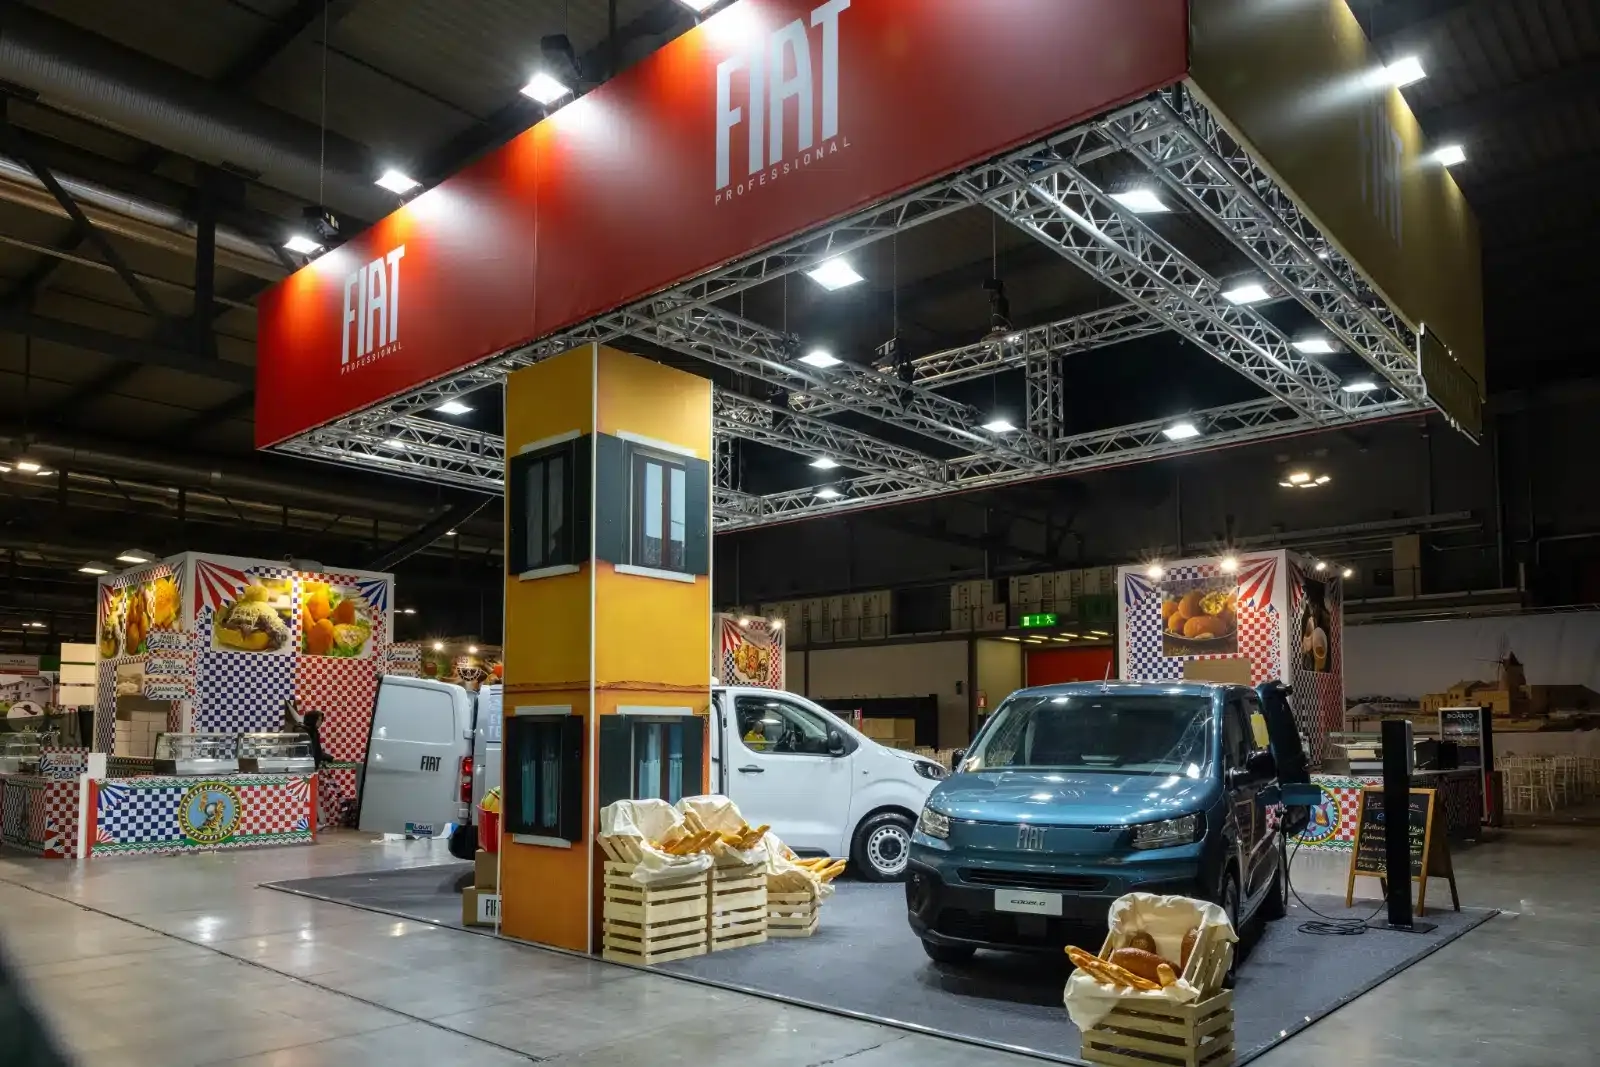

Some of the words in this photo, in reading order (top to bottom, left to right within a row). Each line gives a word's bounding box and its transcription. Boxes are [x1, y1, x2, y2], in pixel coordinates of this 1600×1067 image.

[716, 0, 851, 190] FIAT
[714, 136, 851, 206] PROFESSIONAL
[341, 244, 405, 365] FIAT
[341, 341, 403, 375] PROFESSIONAL
[420, 755, 442, 772] FIAT
[1016, 824, 1048, 849] FIAT
